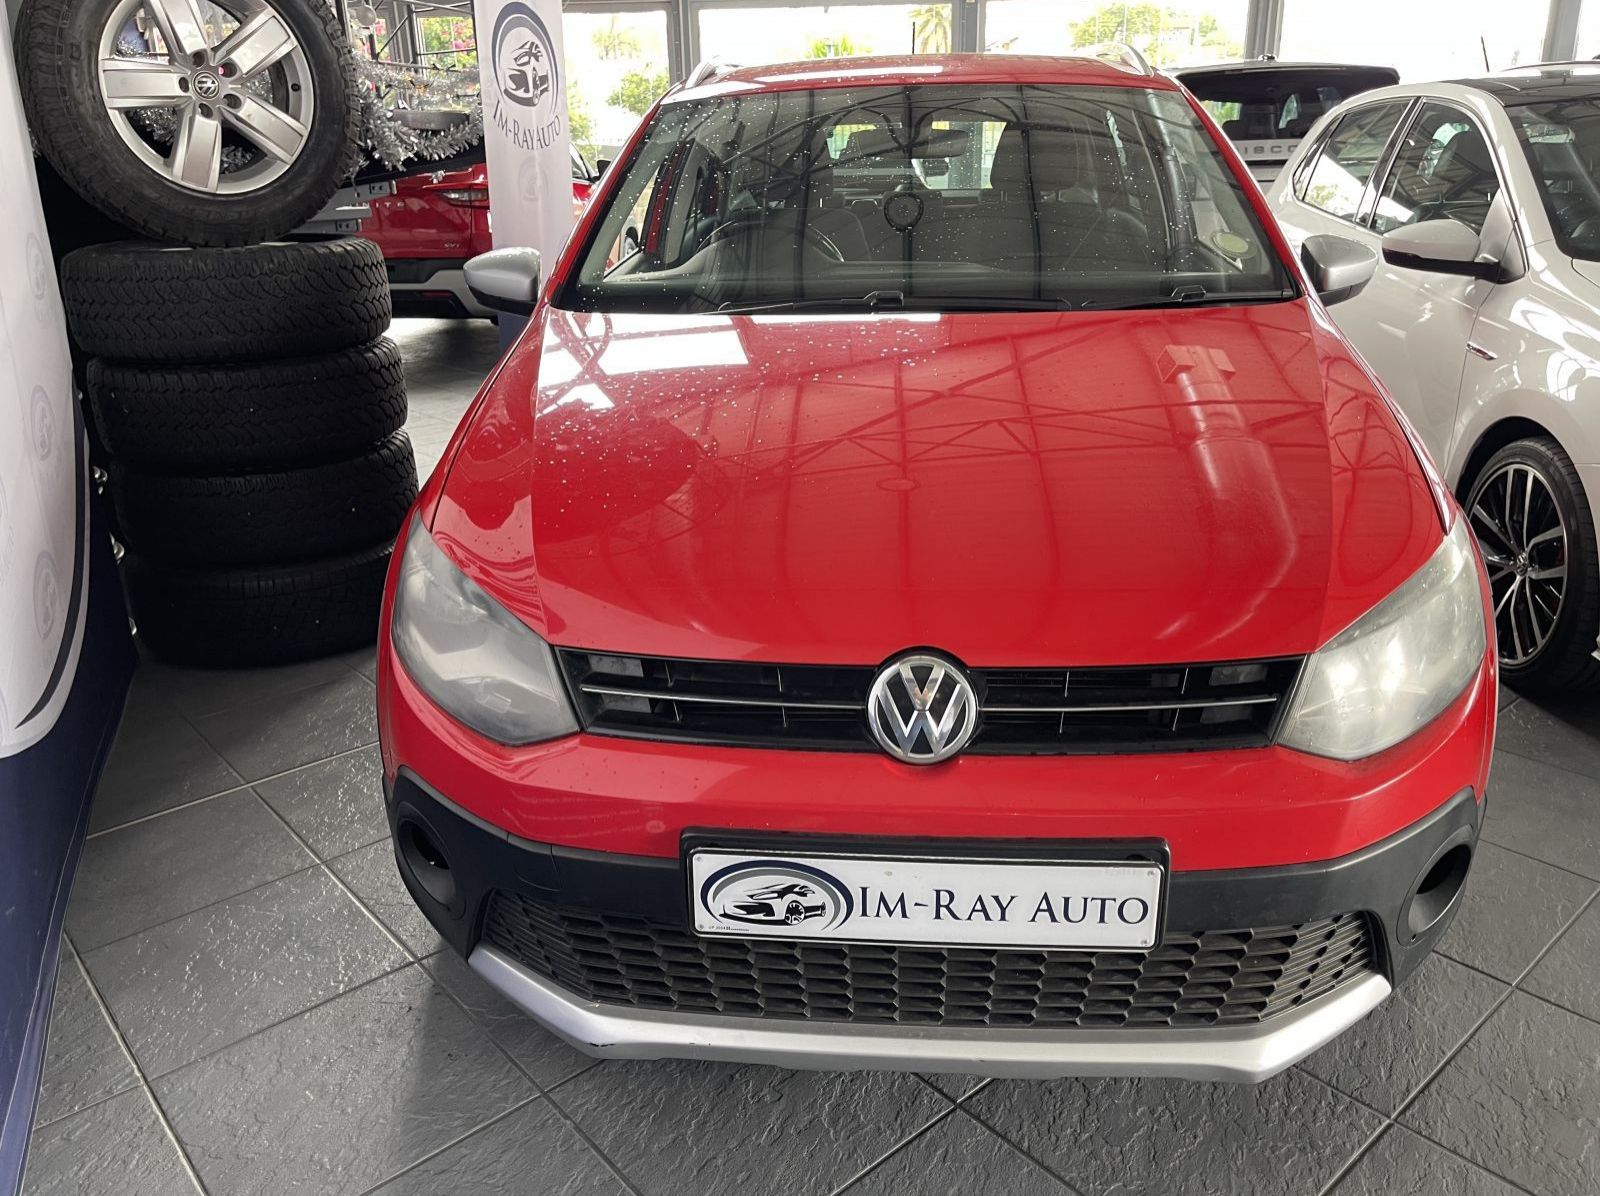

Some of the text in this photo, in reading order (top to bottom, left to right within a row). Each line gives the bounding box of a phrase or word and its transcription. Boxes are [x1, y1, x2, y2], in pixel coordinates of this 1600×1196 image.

[536, 114, 561, 149] AUTO
[859, 885, 1150, 926] IM-RAY AUTO
